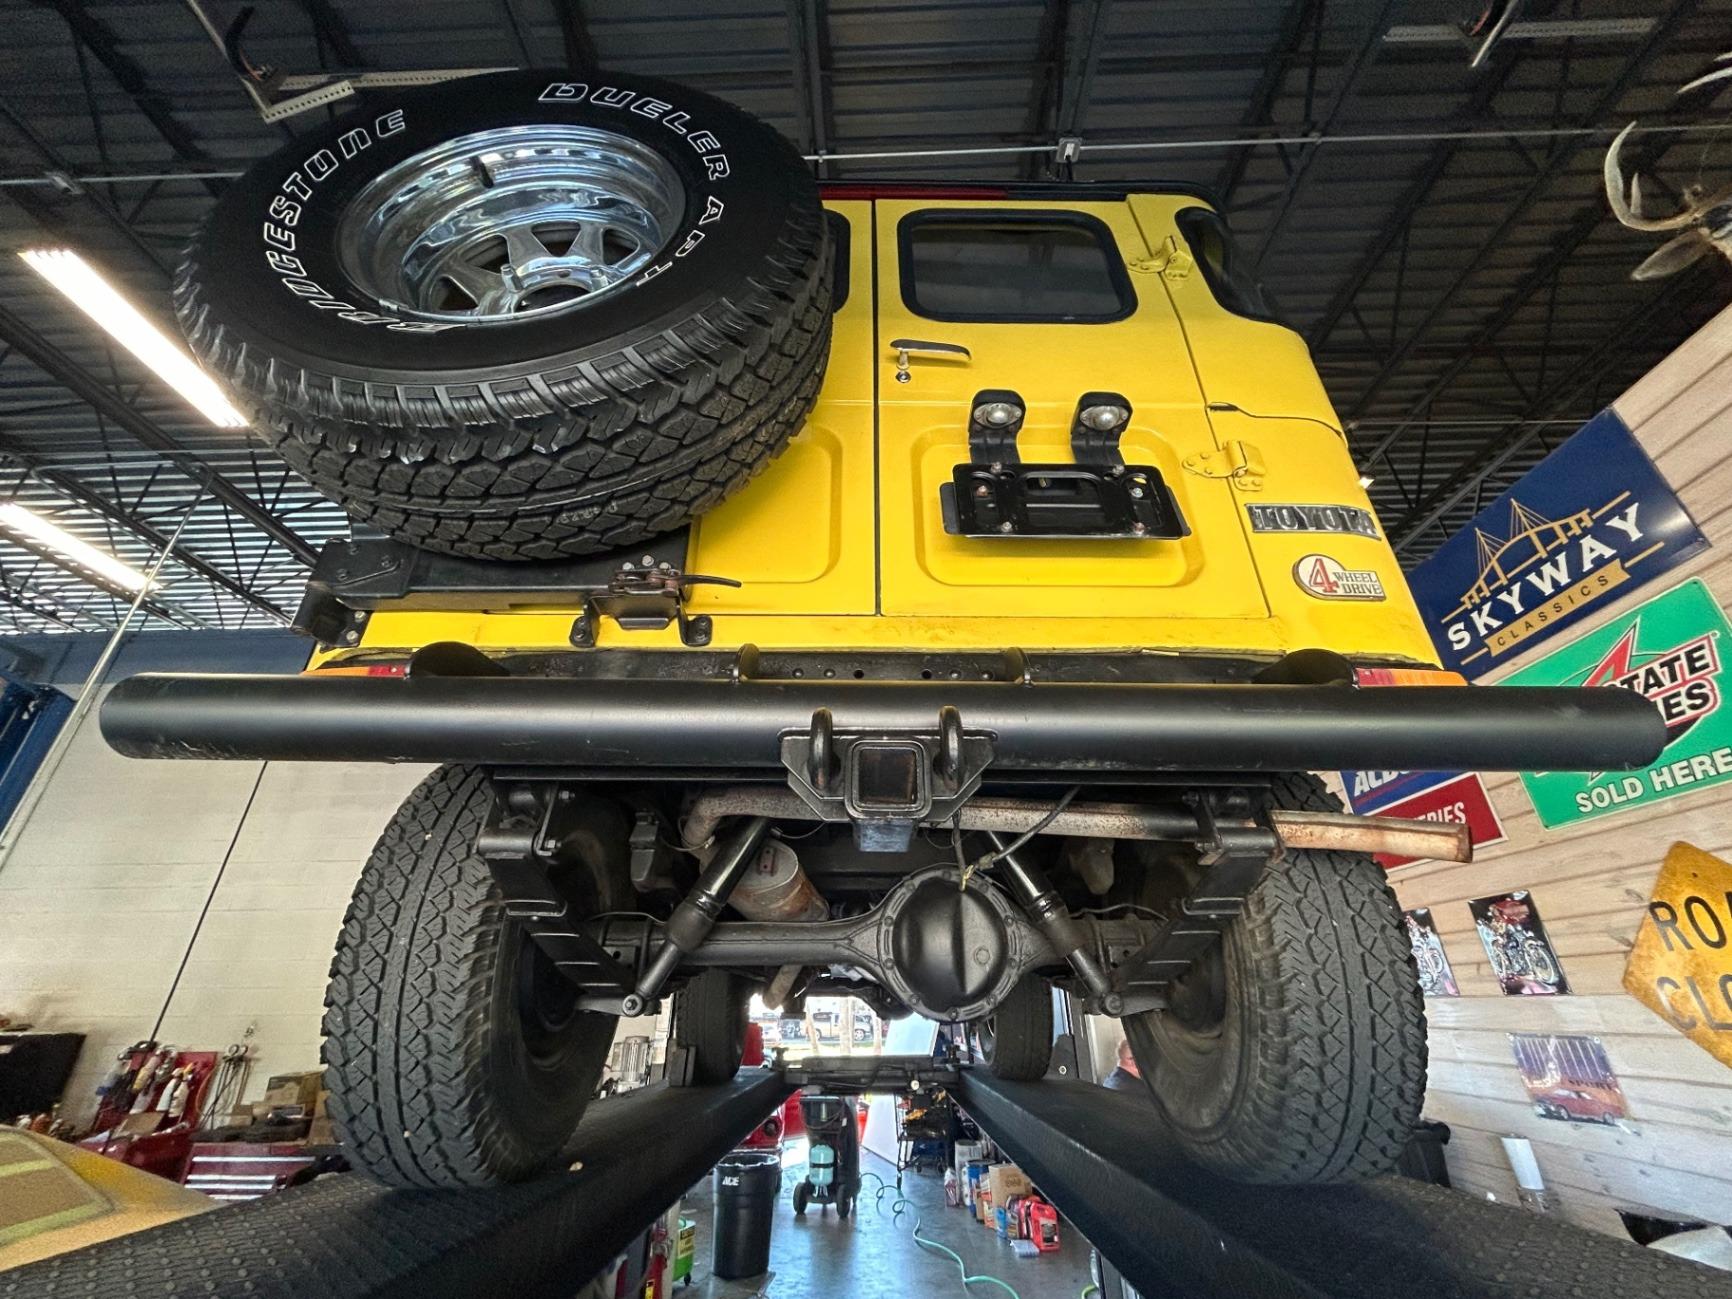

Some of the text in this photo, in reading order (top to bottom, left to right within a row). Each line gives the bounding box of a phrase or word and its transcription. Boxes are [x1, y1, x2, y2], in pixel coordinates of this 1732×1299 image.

[538, 83, 730, 181] DUELER
[264, 109, 467, 333] BRIDGESTONE
[1252, 505, 1378, 536] TOYOTA
[1308, 558, 1378, 593] 4 WHEEL
[1341, 583, 1383, 595] DRIVE
[1447, 502, 1644, 651] SKYWAY
[1496, 575, 1609, 647] CLASSICS
[1604, 643, 1711, 695] TATE
[1575, 747, 1732, 813] SOLD HERE
[1649, 891, 1732, 951] RO
[722, 1175, 739, 1187] ACE
